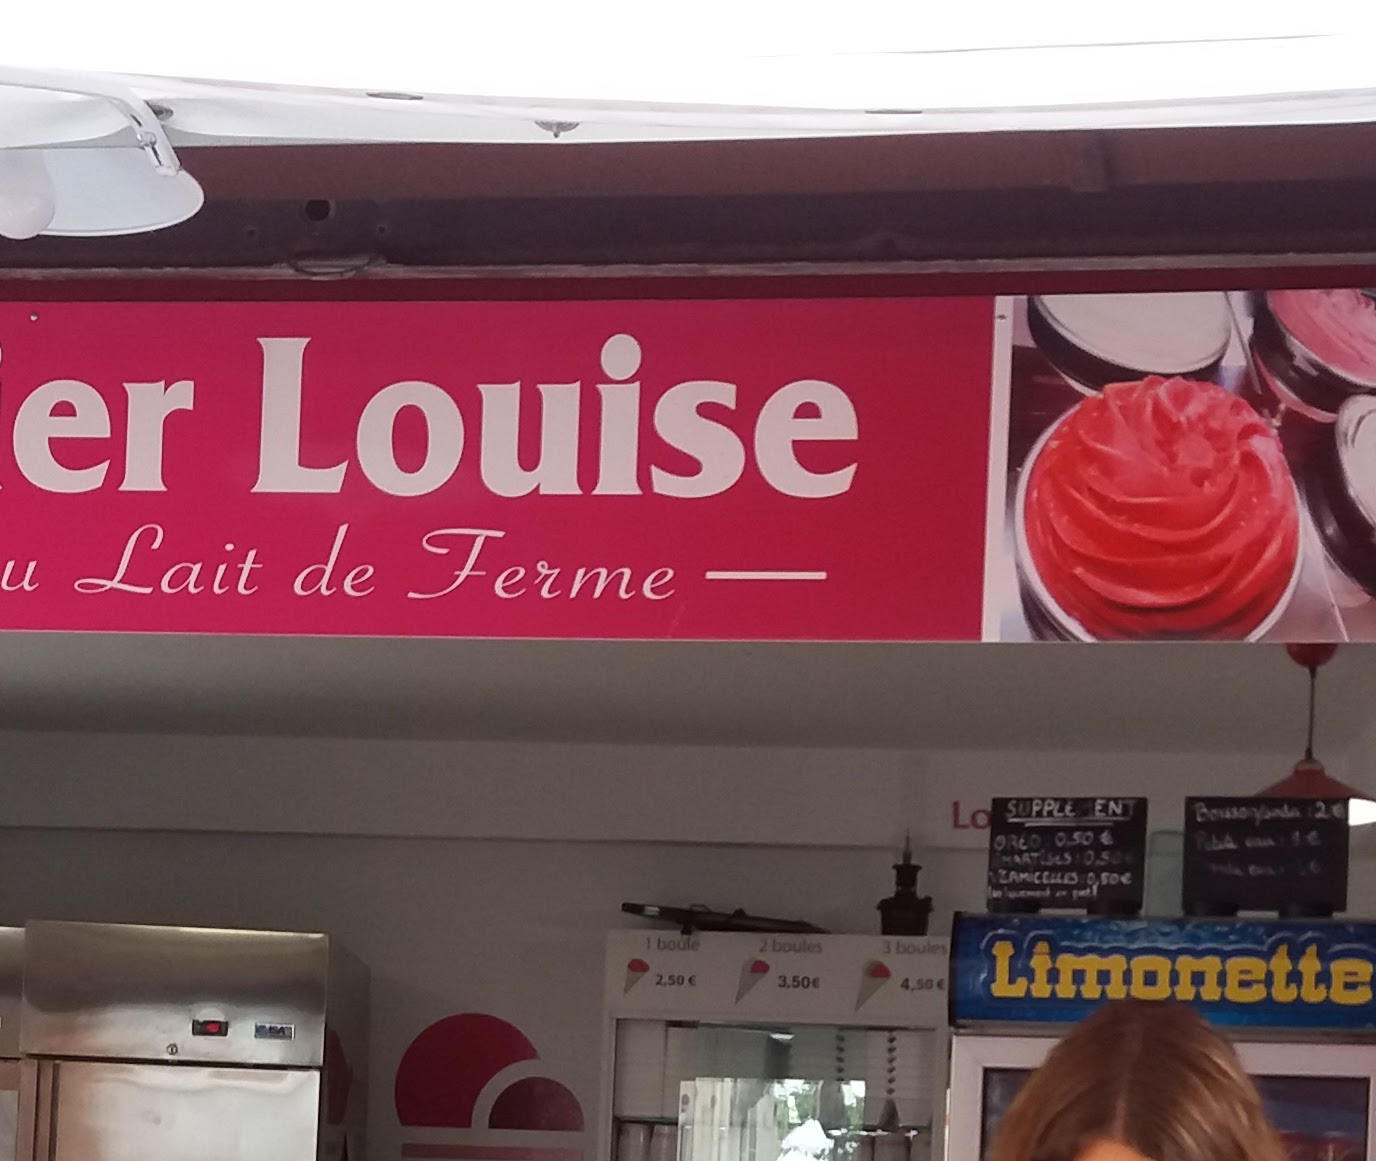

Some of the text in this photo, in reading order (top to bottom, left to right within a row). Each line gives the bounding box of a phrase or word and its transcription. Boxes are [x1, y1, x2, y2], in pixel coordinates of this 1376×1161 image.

[249, 331, 861, 499] Louise
[72, 519, 259, 598] Lait
[291, 525, 378, 598] de
[406, 527, 677, 607] Ferme
[656, 937, 700, 952] boule
[758, 938, 768, 953] 2
[990, 940, 1375, 1006] Limonette
